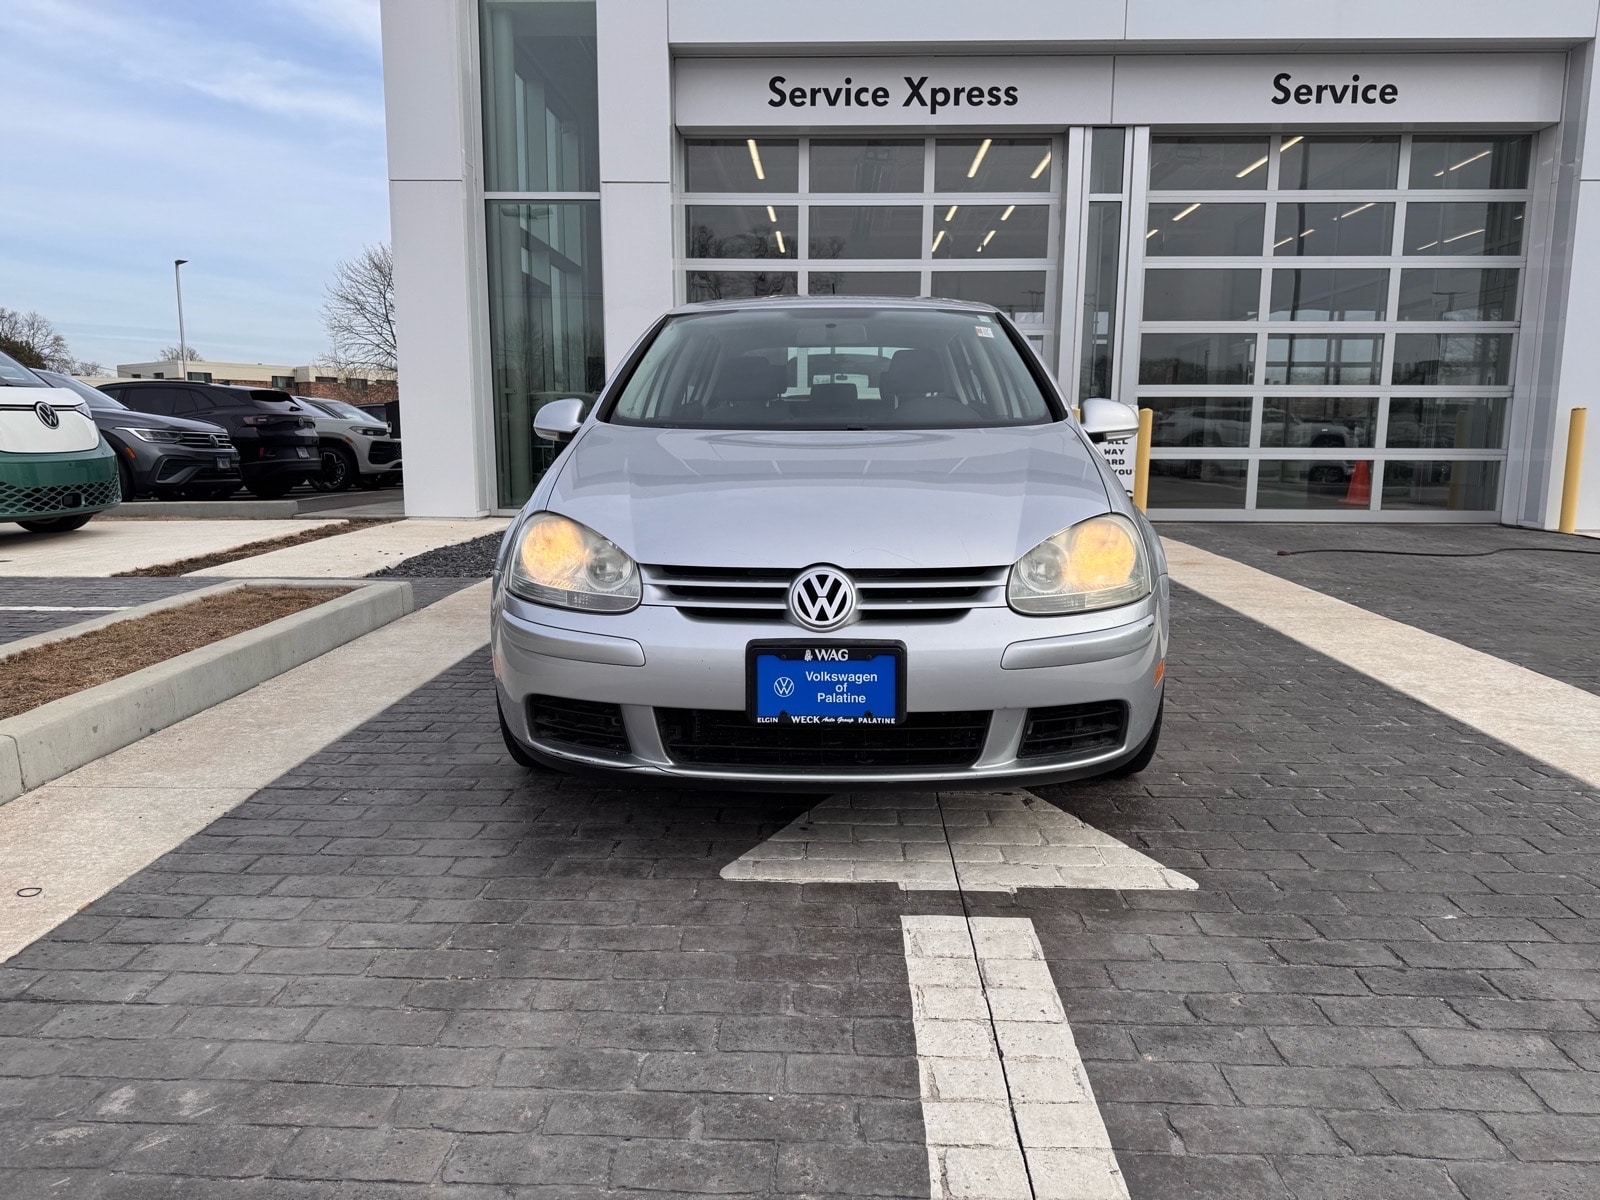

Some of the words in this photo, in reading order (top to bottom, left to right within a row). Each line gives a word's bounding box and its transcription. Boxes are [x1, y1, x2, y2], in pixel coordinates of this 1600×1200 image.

[1271, 73, 1398, 105] Service
[768, 76, 890, 107] Service
[902, 76, 1018, 115] Xpress
[815, 649, 849, 661] WAG
[805, 671, 878, 684] Volkswagen
[835, 683, 848, 692] of
[817, 692, 867, 703] Palatine
[791, 715, 820, 724] WECK
